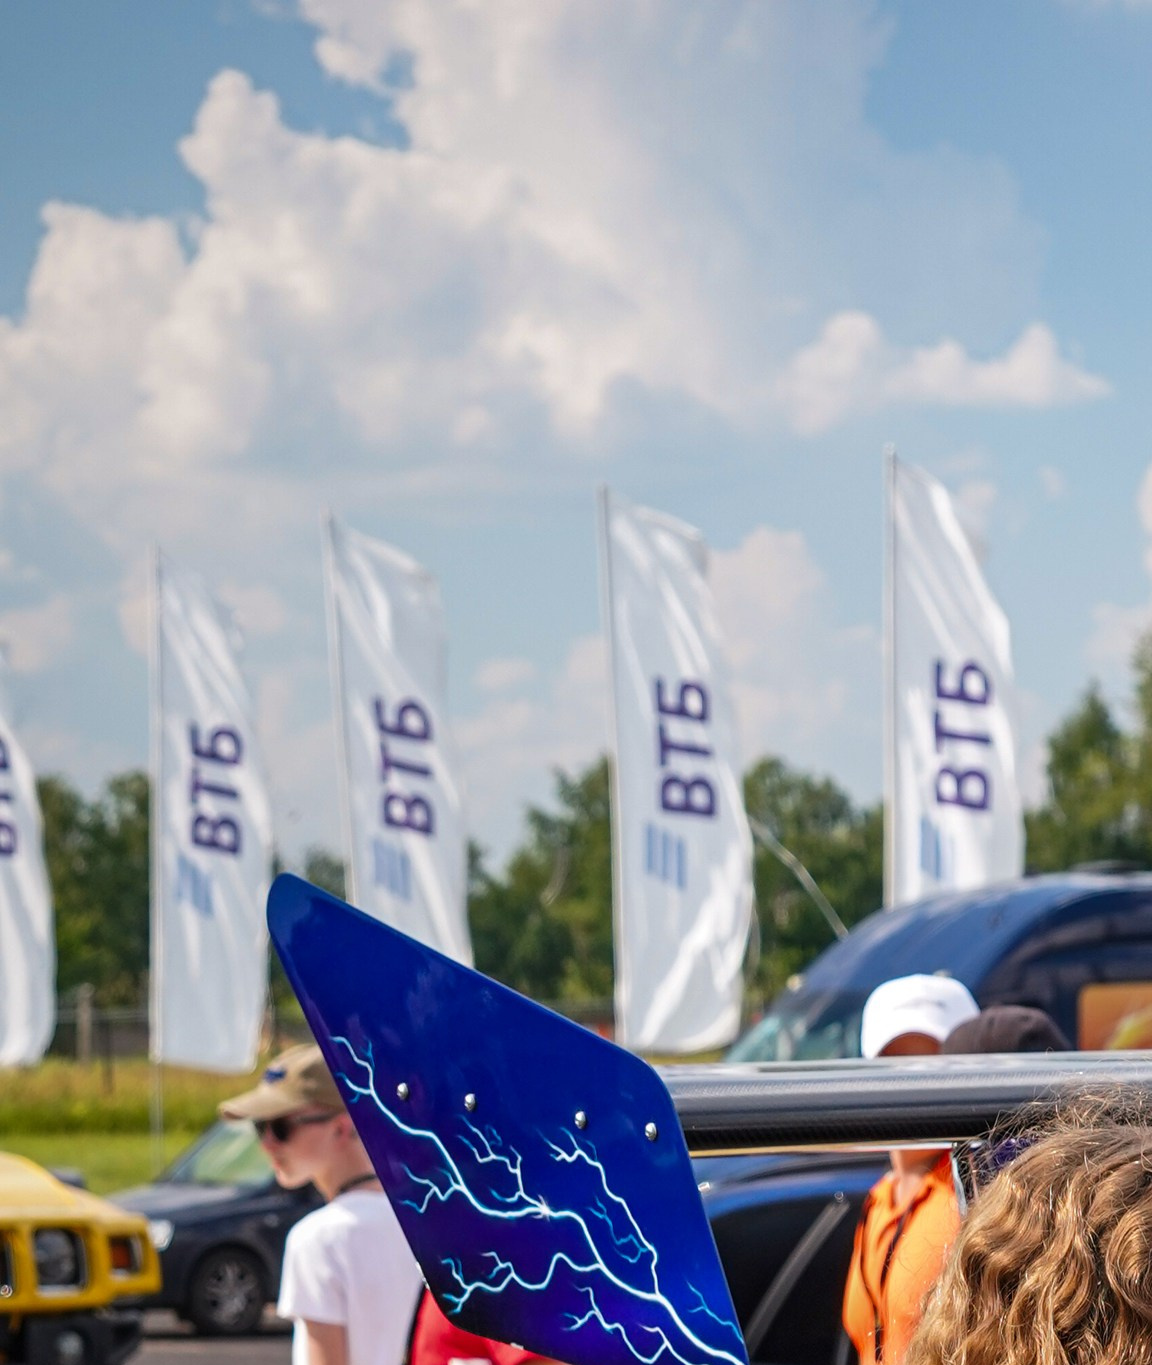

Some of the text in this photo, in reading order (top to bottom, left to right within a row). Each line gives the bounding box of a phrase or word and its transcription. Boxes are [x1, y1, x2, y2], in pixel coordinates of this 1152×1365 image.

[189, 722, 244, 857] ВТБ
[372, 694, 434, 838] ВТБ
[653, 676, 717, 820] ВТБ
[933, 655, 994, 813] ВТБ
